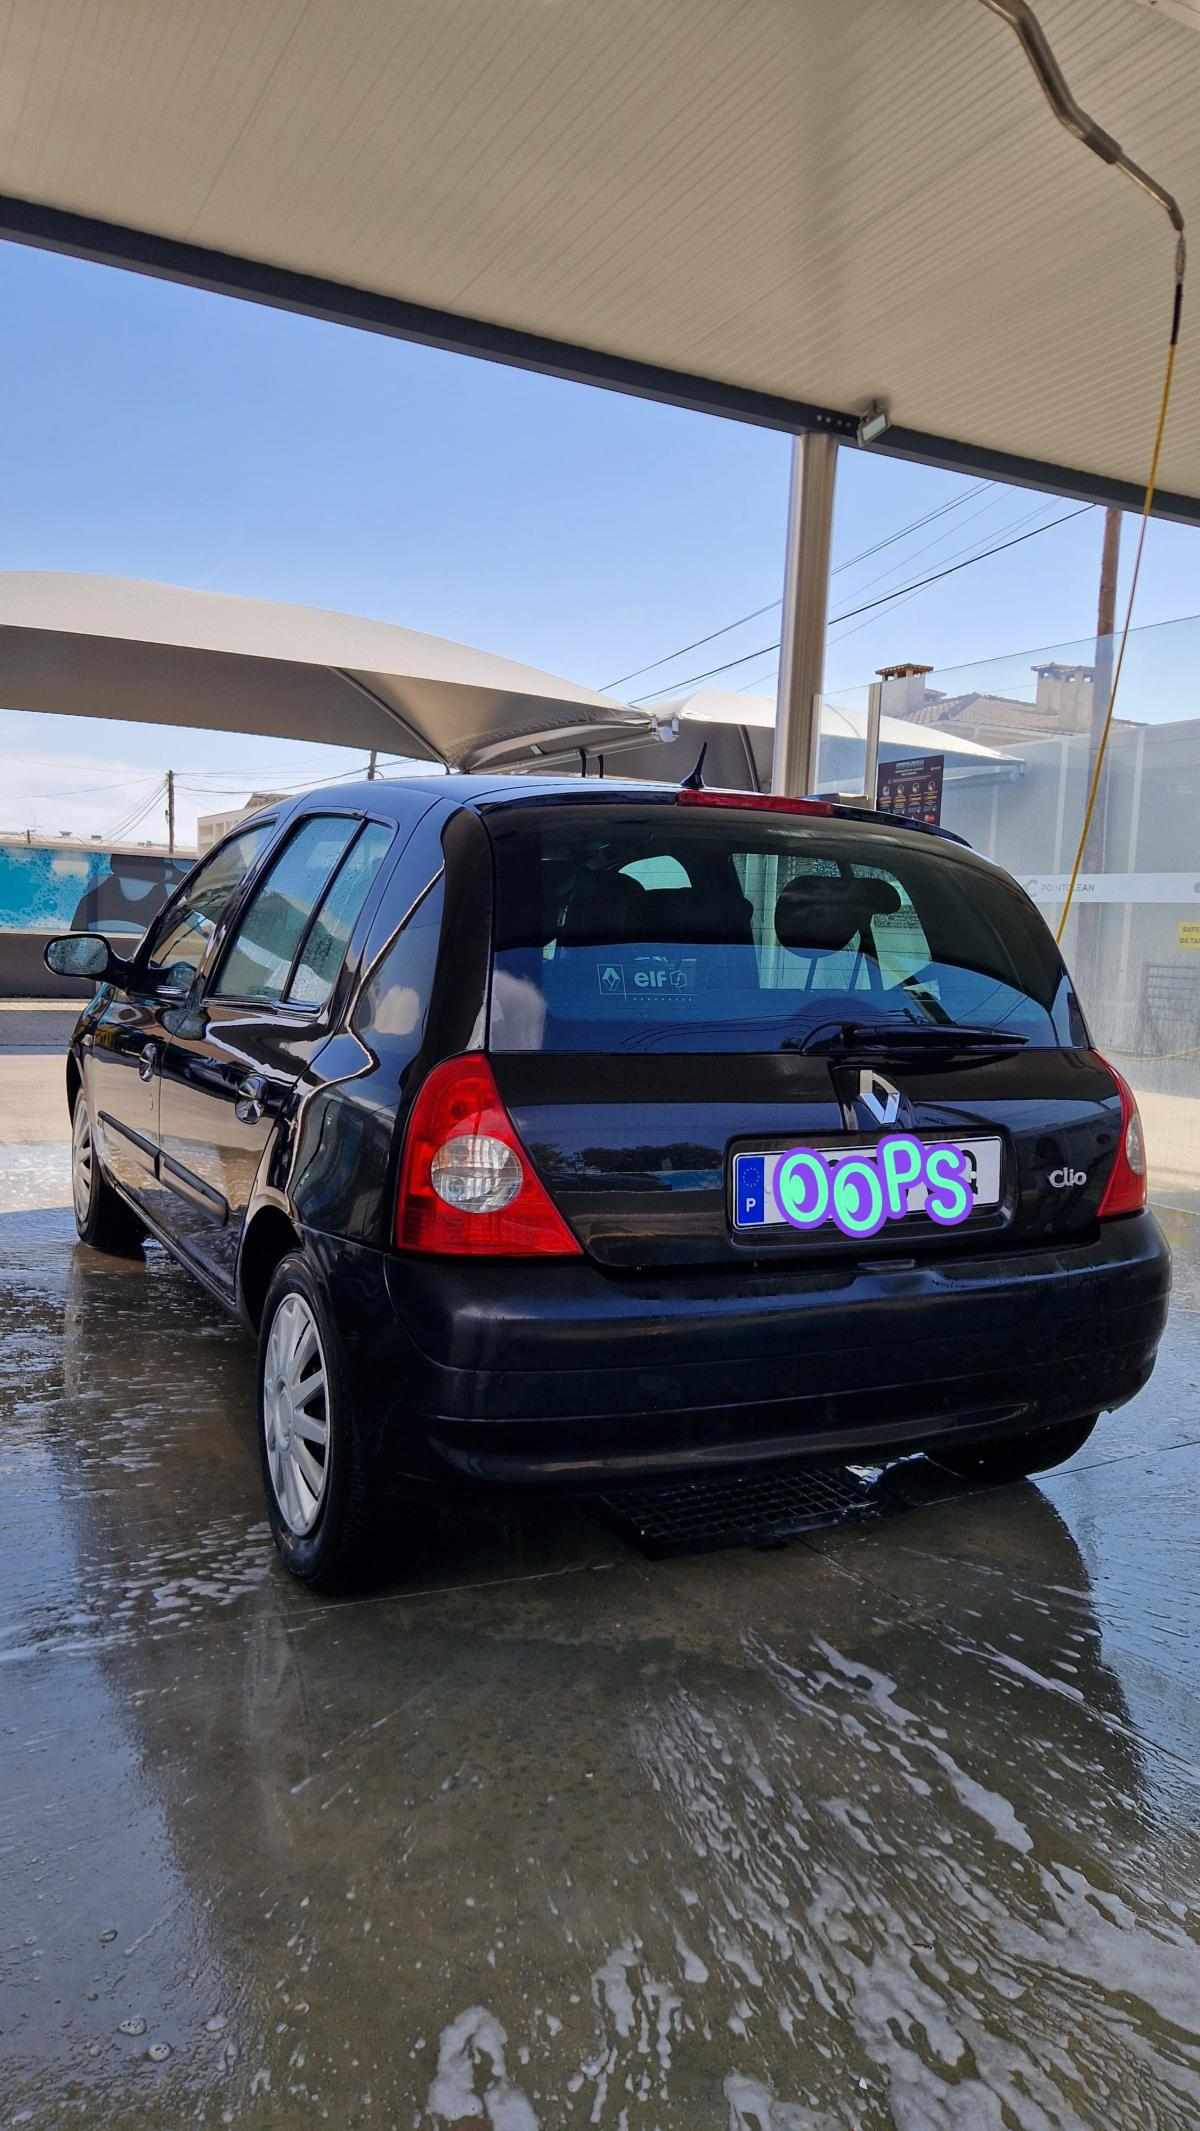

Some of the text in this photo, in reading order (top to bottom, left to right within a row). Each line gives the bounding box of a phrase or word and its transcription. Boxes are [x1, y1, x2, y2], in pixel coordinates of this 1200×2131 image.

[634, 971, 667, 987] elf
[1048, 1167, 1087, 1188] Clio
[746, 1198, 756, 1213] P
